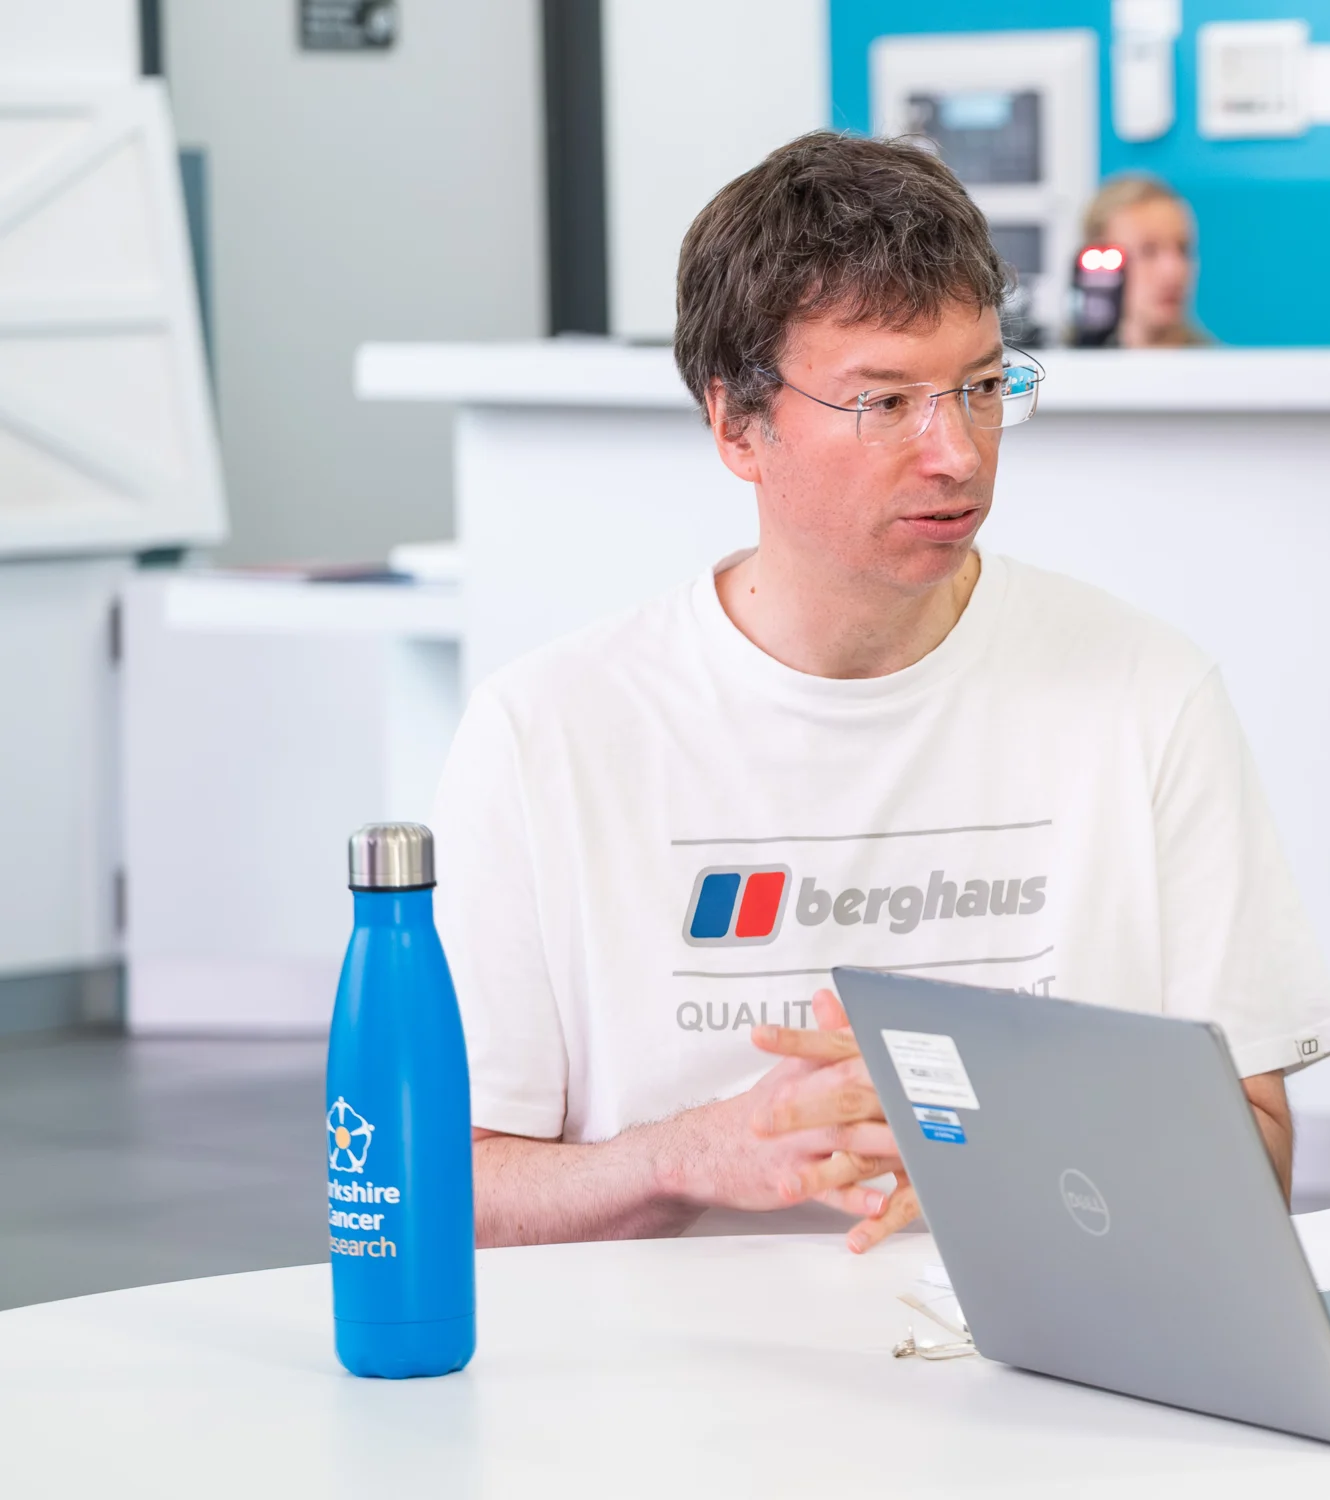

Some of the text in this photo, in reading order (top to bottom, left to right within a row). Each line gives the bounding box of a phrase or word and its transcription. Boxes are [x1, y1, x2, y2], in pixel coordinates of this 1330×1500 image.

[795, 870, 1047, 935] berghaus
[676, 1000, 812, 1032] QUALIT
[327, 1178, 400, 1204] rkshire
[328, 1235, 397, 1258] esearch
